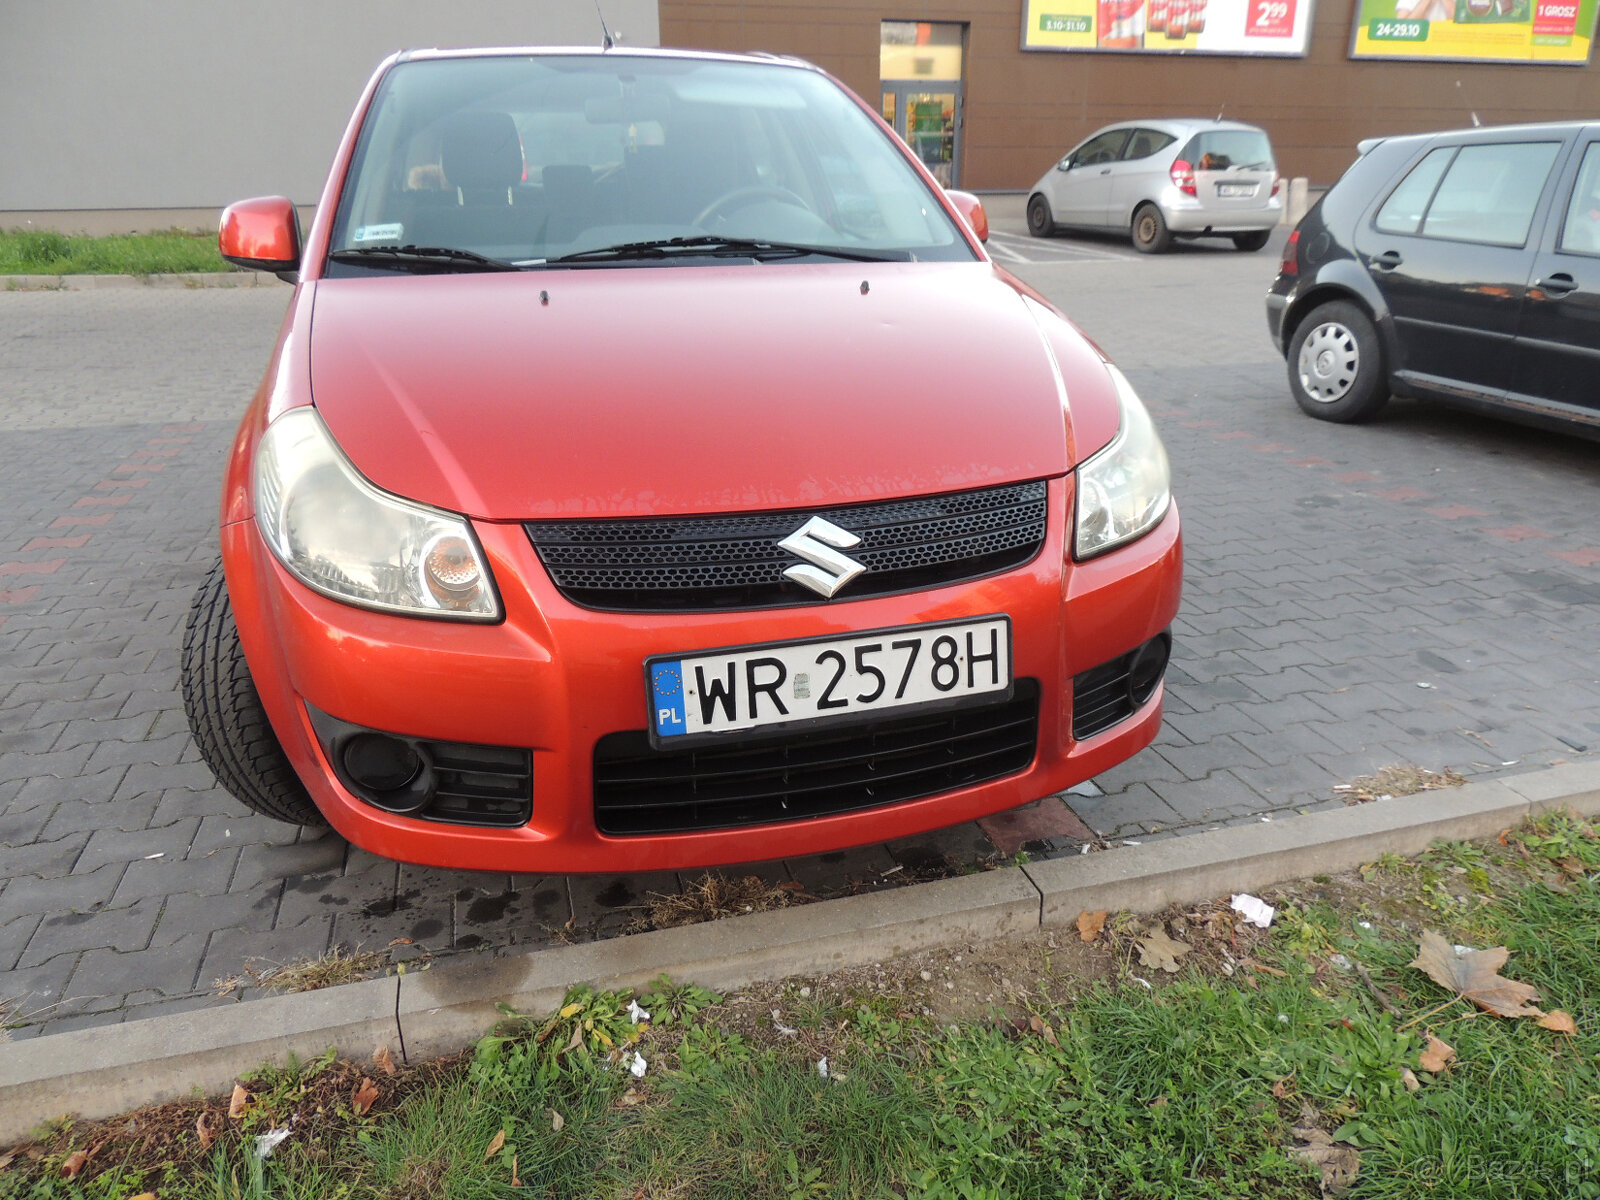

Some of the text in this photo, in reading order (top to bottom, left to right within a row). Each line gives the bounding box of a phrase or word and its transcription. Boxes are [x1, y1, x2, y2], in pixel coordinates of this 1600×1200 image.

[1544, 5, 1576, 18] GROSZ
[1376, 23, 1420, 38] 24-29.10
[694, 628, 999, 725] WR 2578H
[658, 708, 682, 726] PL
